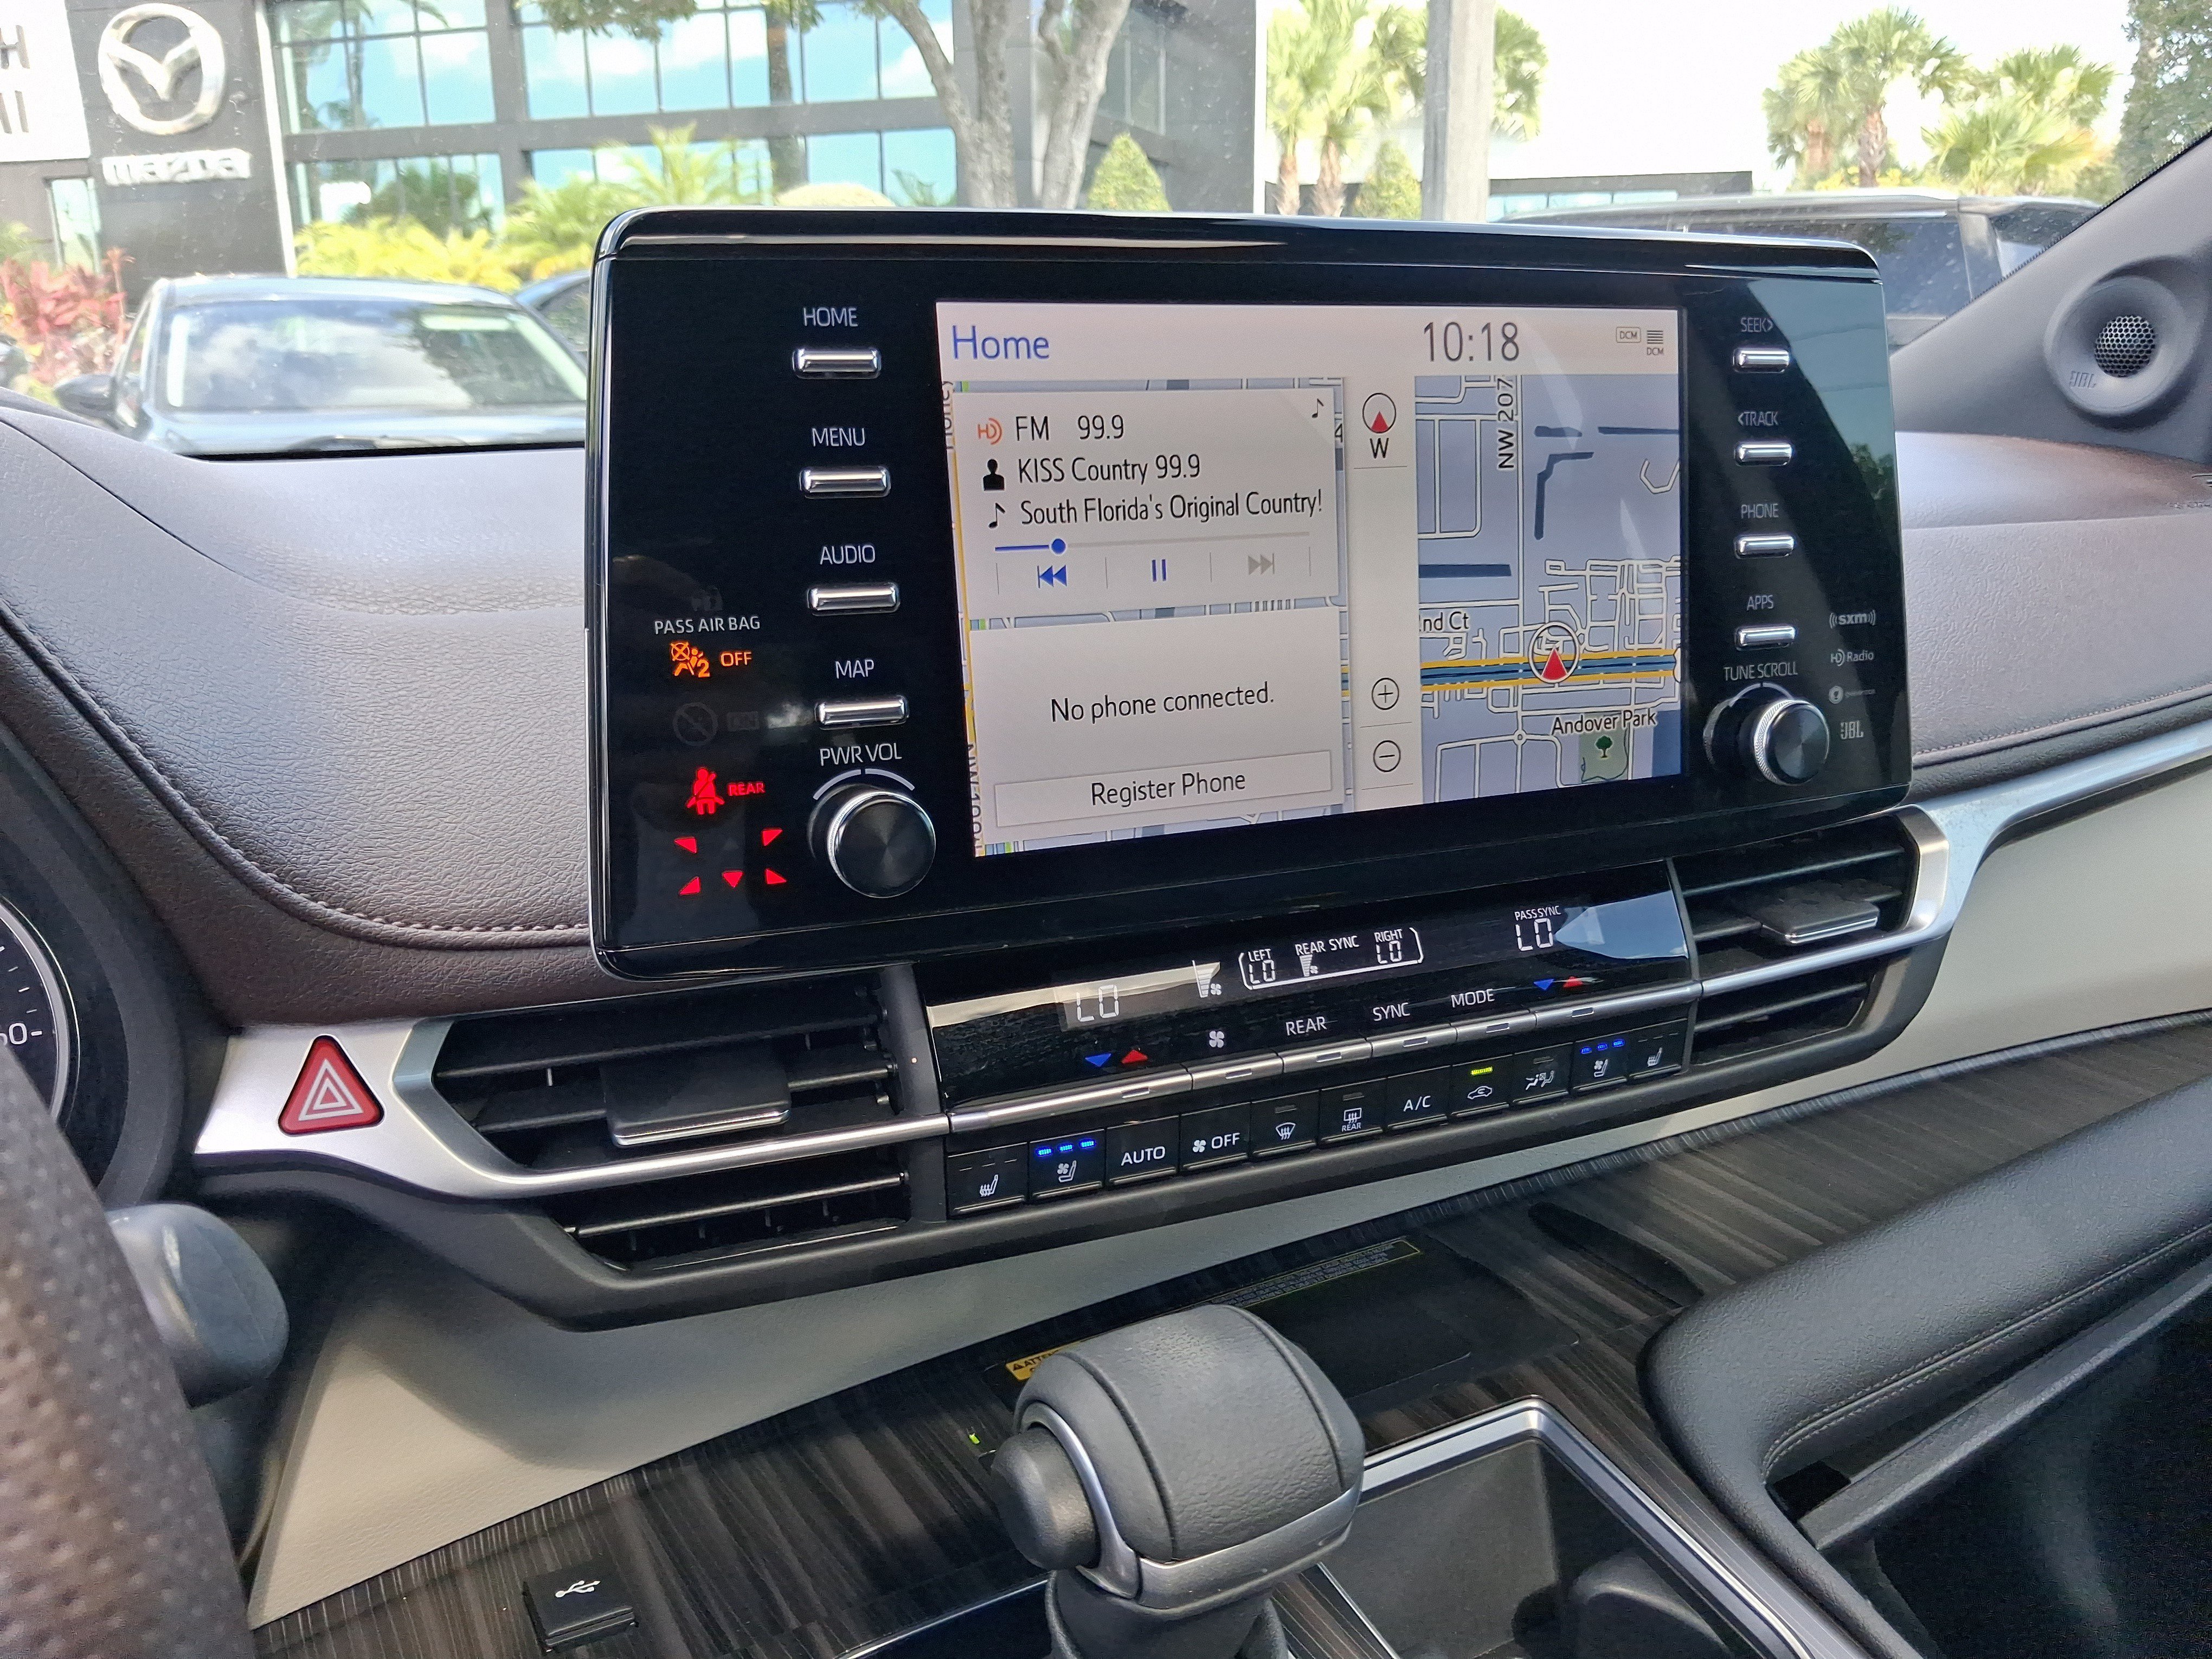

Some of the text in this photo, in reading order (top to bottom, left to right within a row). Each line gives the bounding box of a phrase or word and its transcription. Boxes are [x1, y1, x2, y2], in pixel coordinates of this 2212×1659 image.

[803, 307, 858, 326] HOME
[1741, 318, 1767, 332] SEEK
[952, 325, 1050, 360] Home
[1424, 322, 1519, 362] 10:18
[1619, 331, 1637, 339] DCM
[1646, 347, 1663, 356] DCM
[1015, 416, 1050, 441] FM
[1077, 415, 1124, 440] 99.9
[1497, 378, 1514, 468] NW 207
[1745, 411, 1779, 427] TRACK
[812, 428, 865, 446] MENU
[1369, 438, 1389, 459] W
[1018, 454, 1200, 485] KISS Country 99.9
[1021, 489, 1323, 525] South Florida's Original Country!
[1741, 504, 1779, 518] PHONE
[820, 544, 876, 565] AUDIO
[1746, 595, 1774, 610] APPS
[654, 616, 760, 634] PASS AIR BAG
[1419, 612, 1469, 632] nd Ct
[1838, 613, 1868, 625] sxm
[721, 652, 753, 666] OFF
[1847, 651, 1874, 662] Radio
[835, 659, 874, 679] MAP
[1724, 661, 1798, 680] TUNE SCROLL
[1051, 681, 1275, 724] No phone connected.
[1552, 709, 1656, 735] Andover Park
[1840, 720, 1864, 740] JBL
[820, 743, 902, 766] PWR VOL
[727, 781, 765, 796] REAR
[1091, 771, 1246, 808] Register Phone
[1515, 905, 1561, 920] PASS SYNC
[1295, 935, 1360, 955] REAR SYNC
[1374, 929, 1403, 942] RIGHT
[1248, 949, 1271, 962] LEFT
[1451, 988, 1495, 1008] MODE
[1372, 1002, 1411, 1021] SYNC
[1285, 1016, 1327, 1036] REAR
[1403, 1096, 1431, 1112] A/C
[1341, 1122, 1361, 1132] REAR
[1211, 1133, 1240, 1150] OFF
[1120, 1146, 1166, 1166] AUTO
